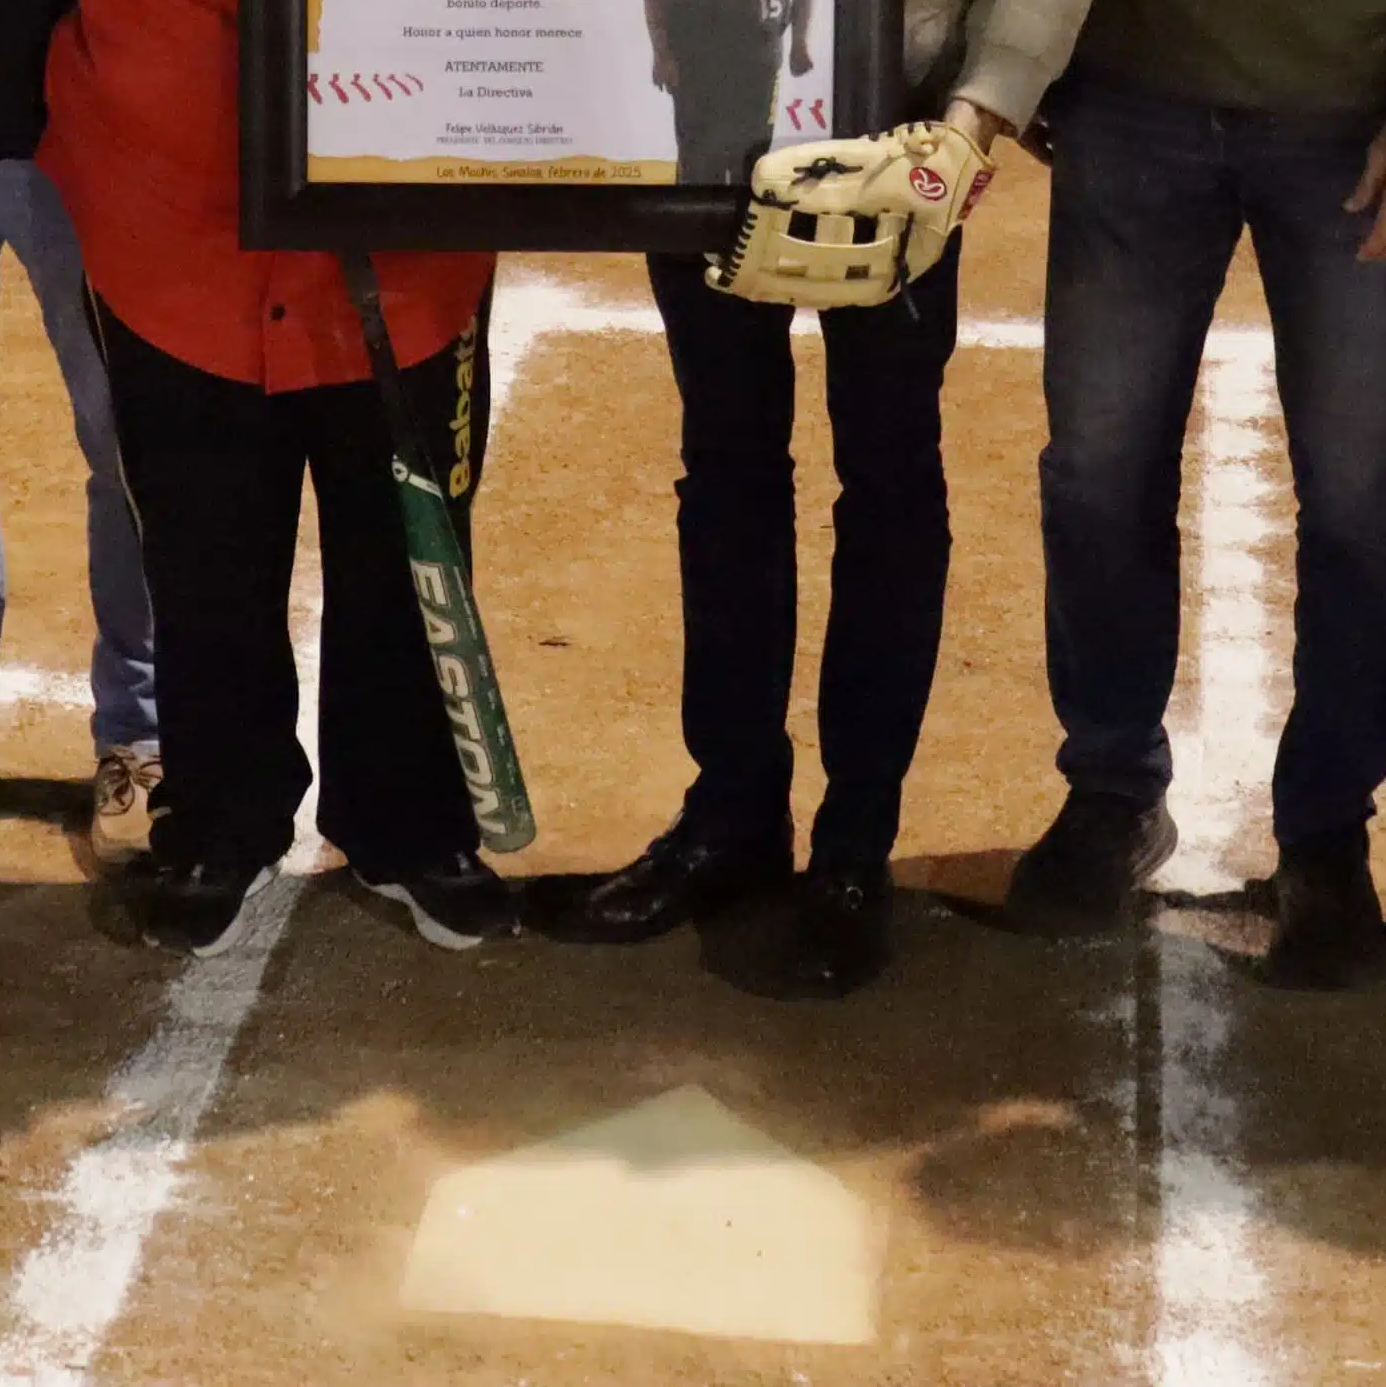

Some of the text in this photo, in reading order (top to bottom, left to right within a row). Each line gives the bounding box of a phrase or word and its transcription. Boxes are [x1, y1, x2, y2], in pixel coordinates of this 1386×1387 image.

[403, 27, 583, 40] Honor a quien honor merece
[444, 61, 545, 72] ATENTAMENTE
[458, 86, 533, 98] La Directiva
[610, 166, 642, 178] 2025
[410, 559, 506, 837] EASTON
